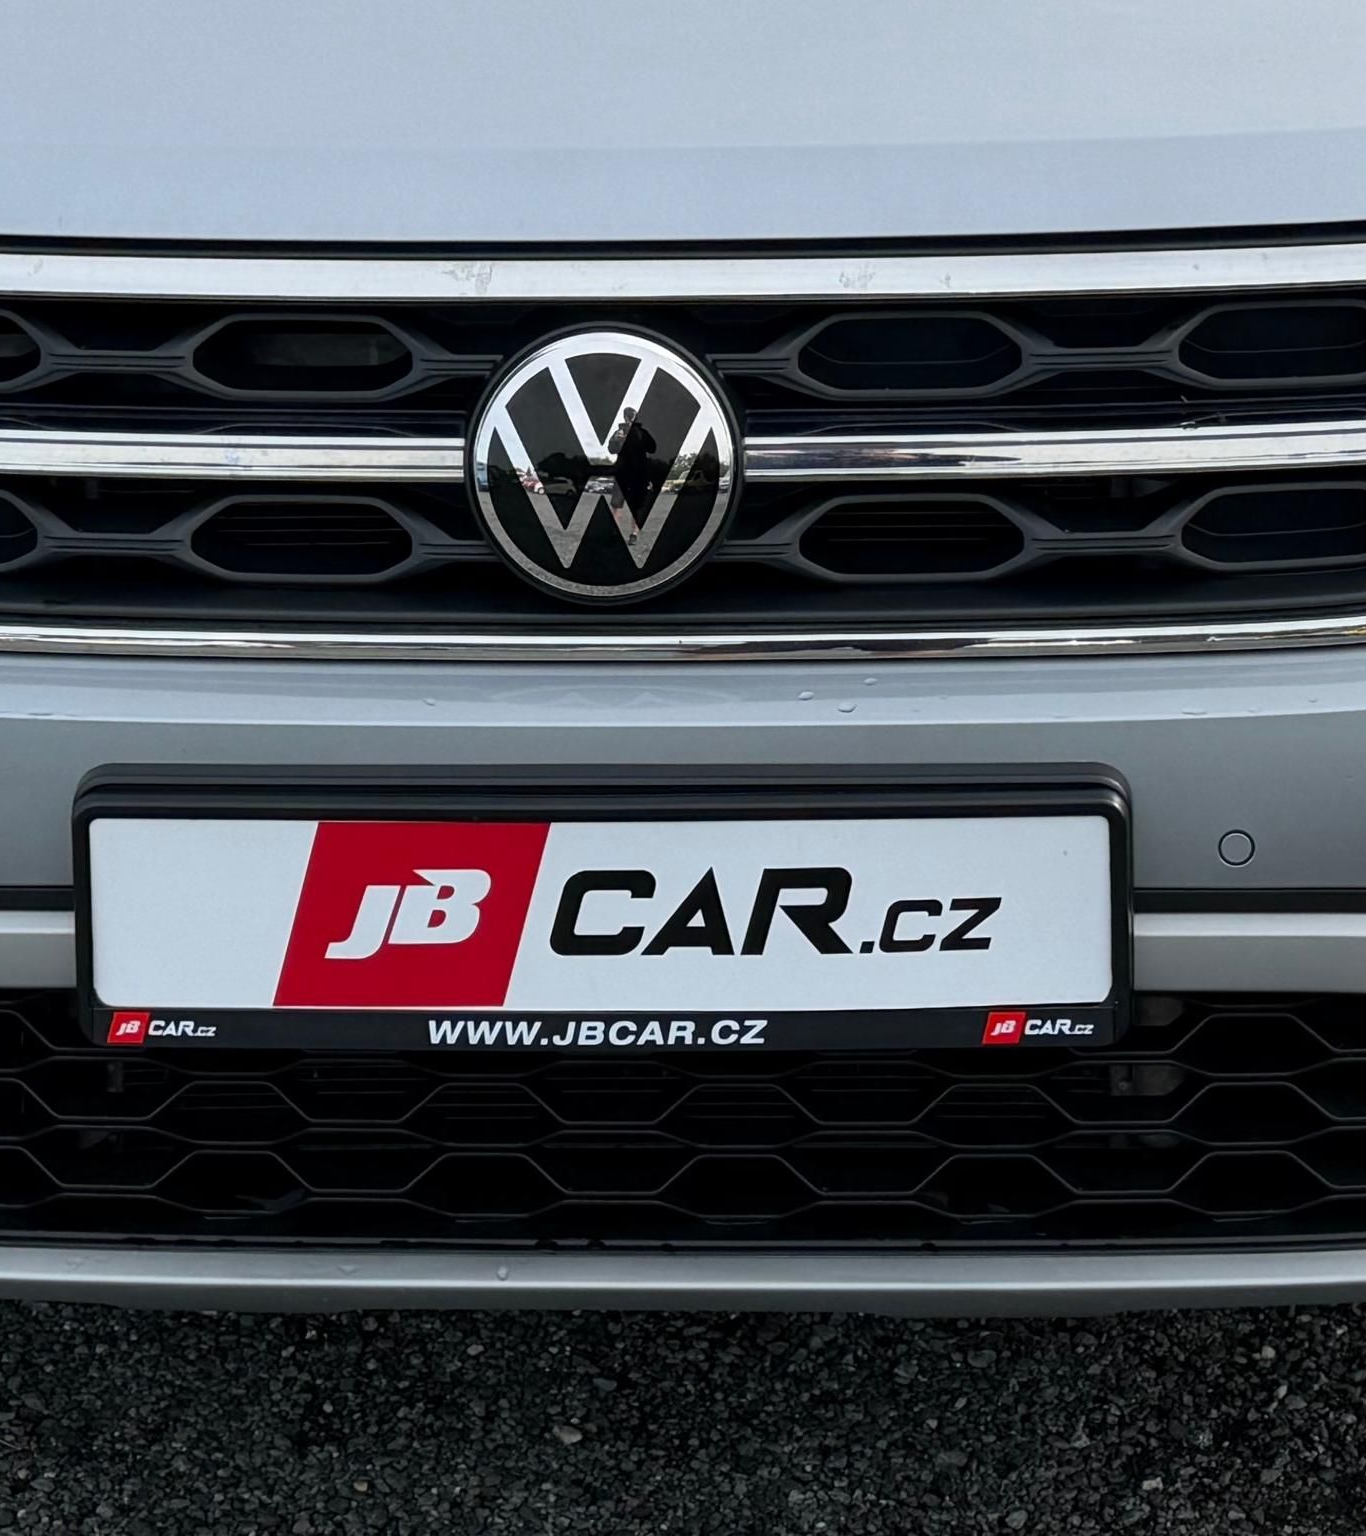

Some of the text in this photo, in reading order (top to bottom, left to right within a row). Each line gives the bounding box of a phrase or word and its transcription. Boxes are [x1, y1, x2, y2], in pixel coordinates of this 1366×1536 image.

[485, 346, 721, 570] VW
[323, 868, 492, 960] JB
[115, 1019, 141, 1036] JB
[428, 1019, 768, 1046] WWW.JBCAR.CZ
[990, 1019, 1017, 1036] JB
